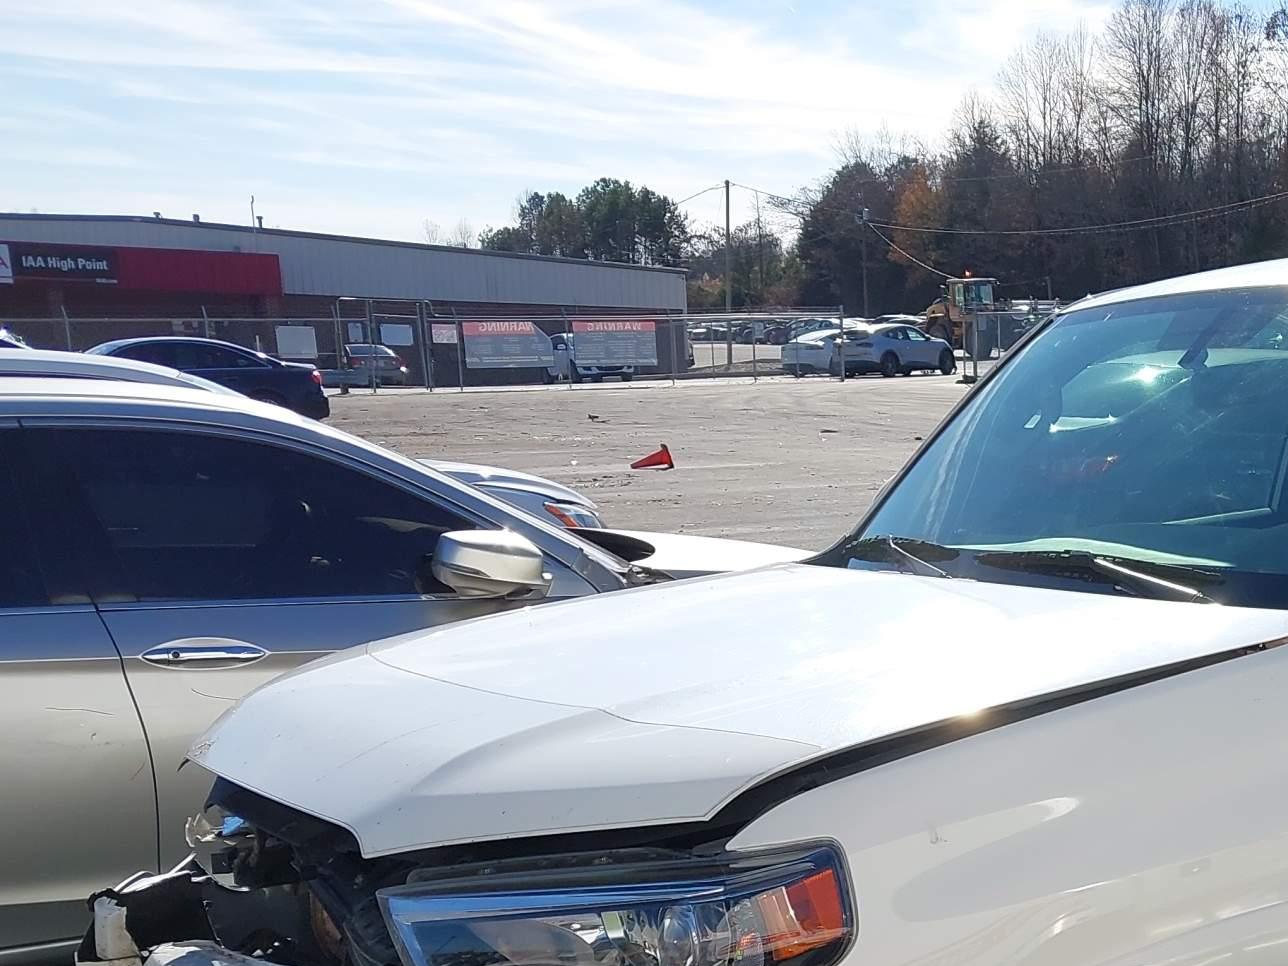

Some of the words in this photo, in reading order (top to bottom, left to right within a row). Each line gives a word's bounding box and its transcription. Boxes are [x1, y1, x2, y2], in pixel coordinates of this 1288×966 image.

[21, 255, 46, 268] IAA
[47, 257, 75, 271] High
[77, 258, 109, 270] Point
